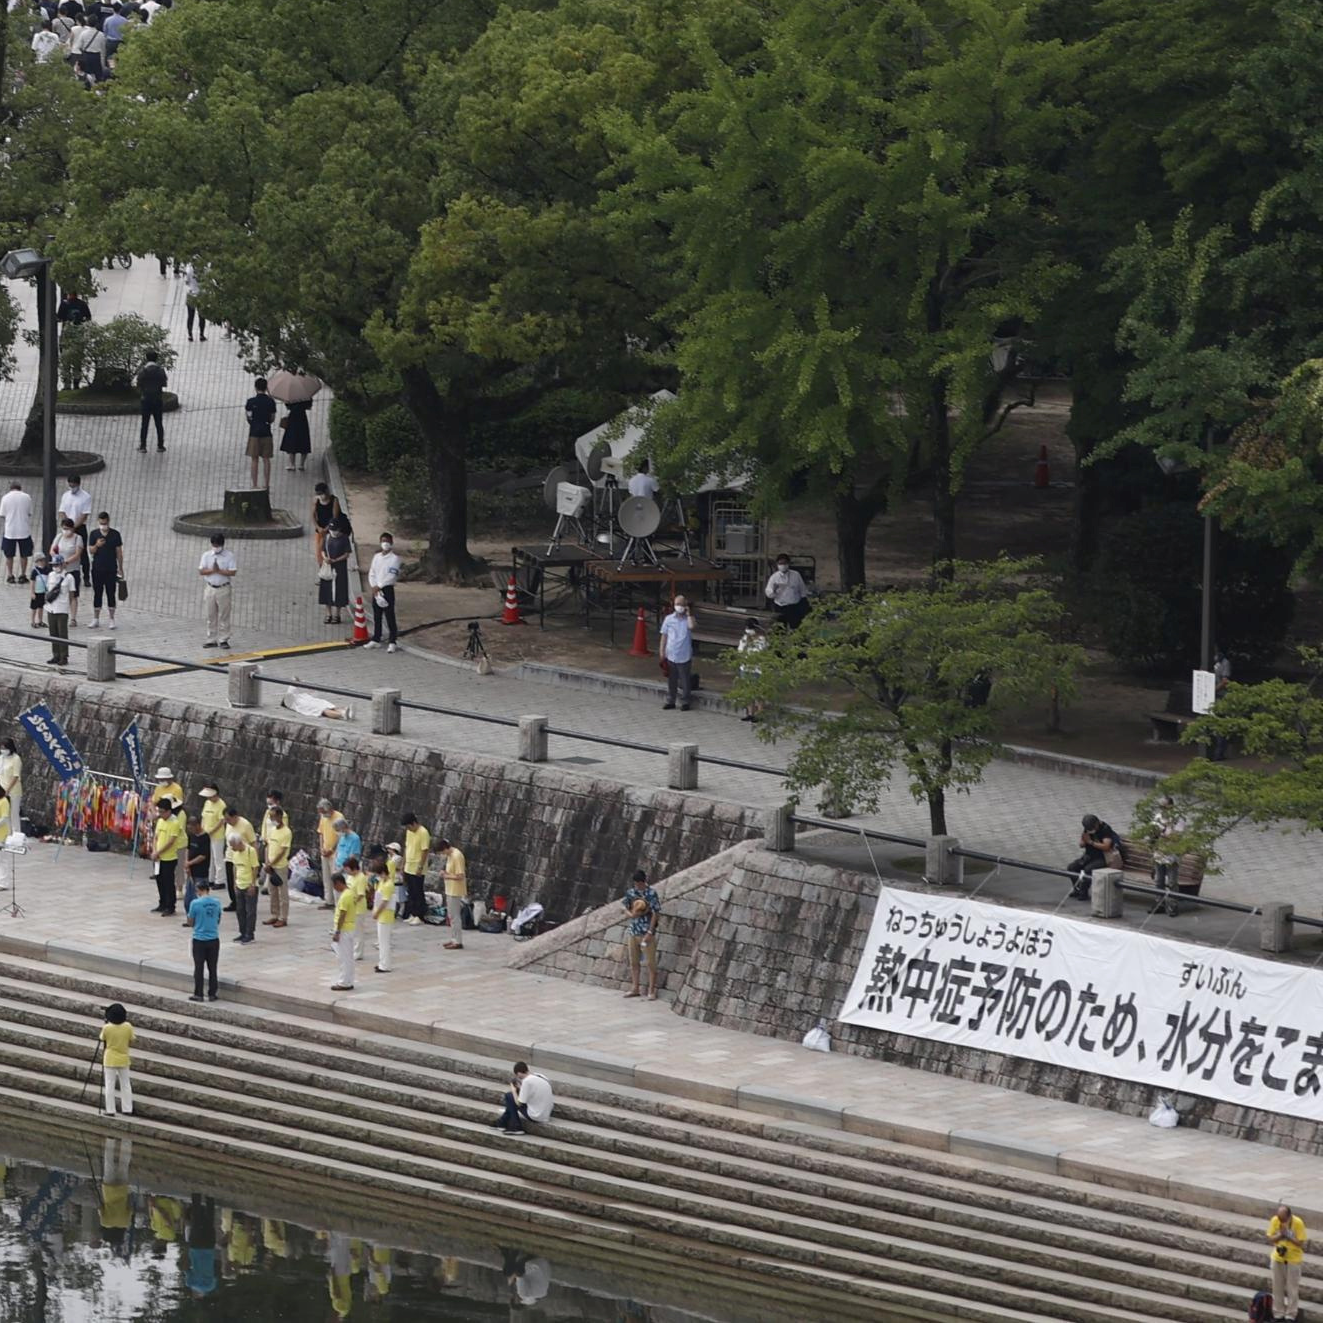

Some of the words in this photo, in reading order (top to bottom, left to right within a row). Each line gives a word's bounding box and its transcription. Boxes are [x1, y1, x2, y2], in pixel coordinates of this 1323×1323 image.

[885, 905, 1054, 958] ねっちゅうしょうよぼう
[1179, 961, 1247, 1000] すいぶん
